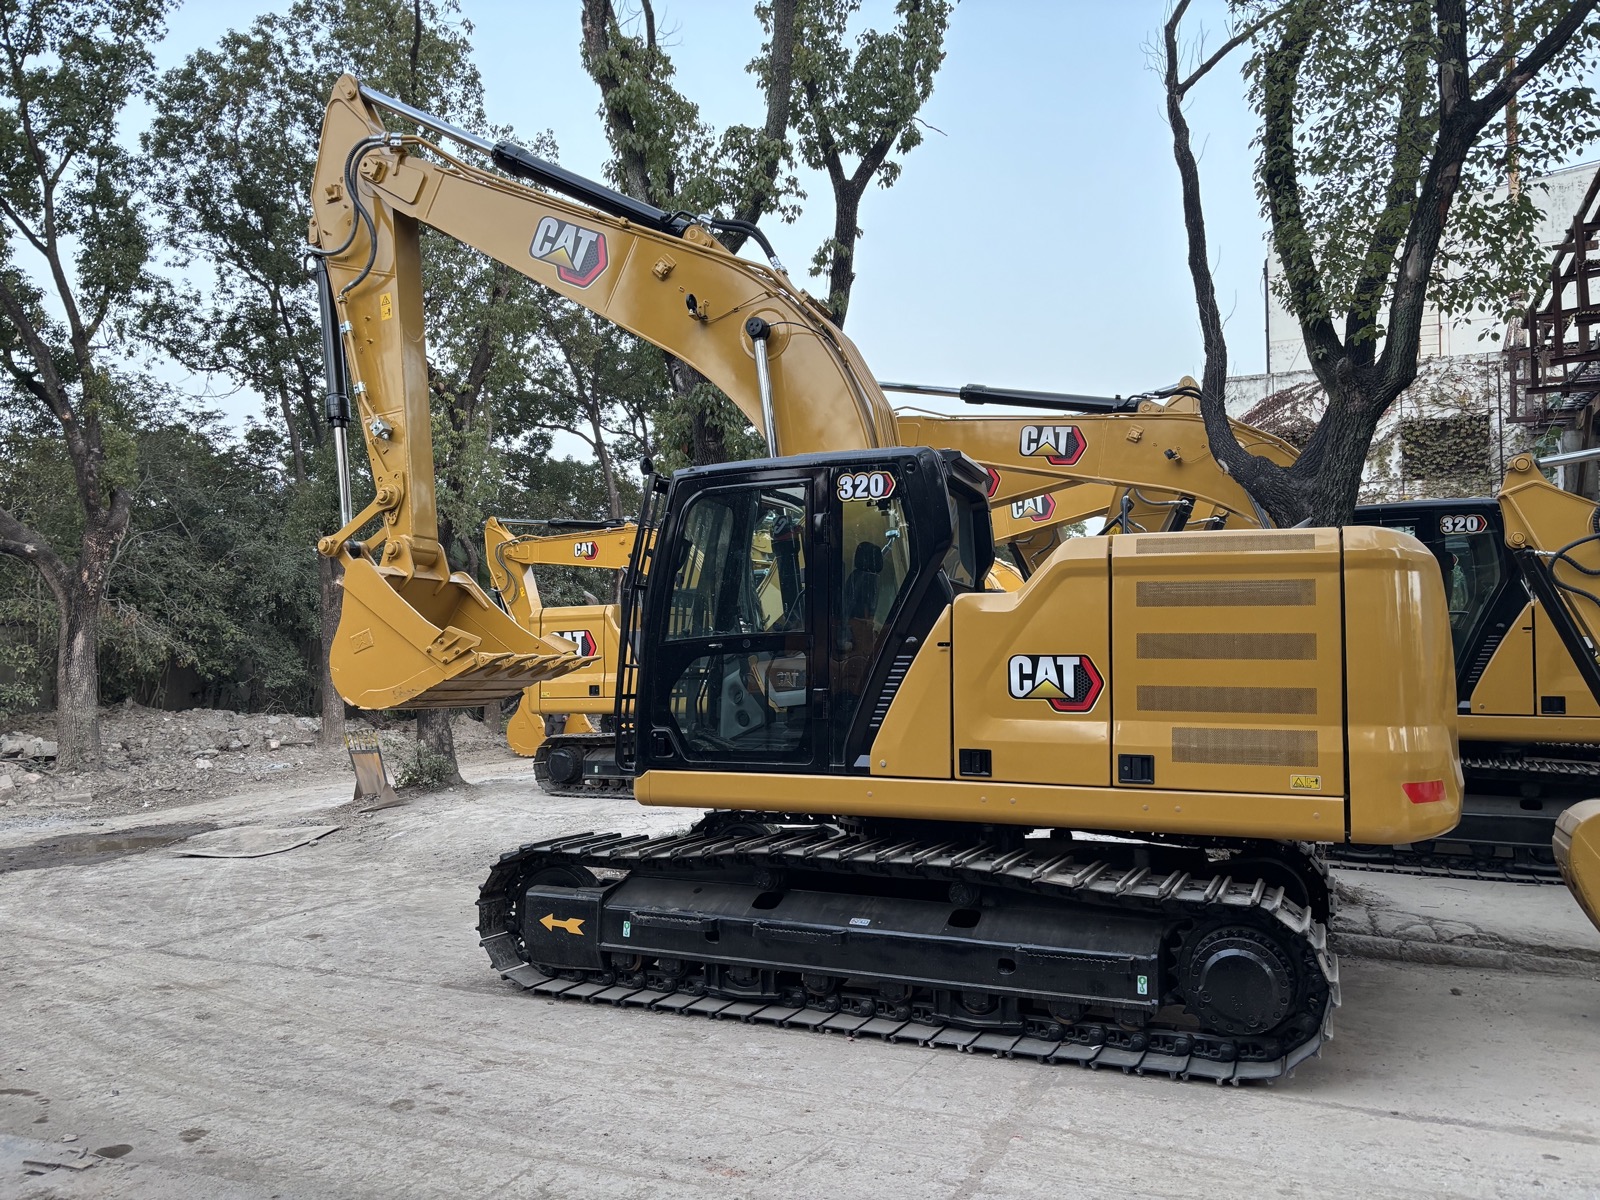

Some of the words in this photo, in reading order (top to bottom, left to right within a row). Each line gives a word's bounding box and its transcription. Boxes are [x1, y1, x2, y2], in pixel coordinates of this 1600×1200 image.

[531, 216, 598, 272] CAT
[1021, 425, 1072, 456] CAT
[839, 473, 884, 499] 320
[1012, 495, 1045, 519] CAT
[1442, 516, 1478, 532] 320
[574, 542, 593, 557] CAT
[1009, 655, 1080, 699] CAT
